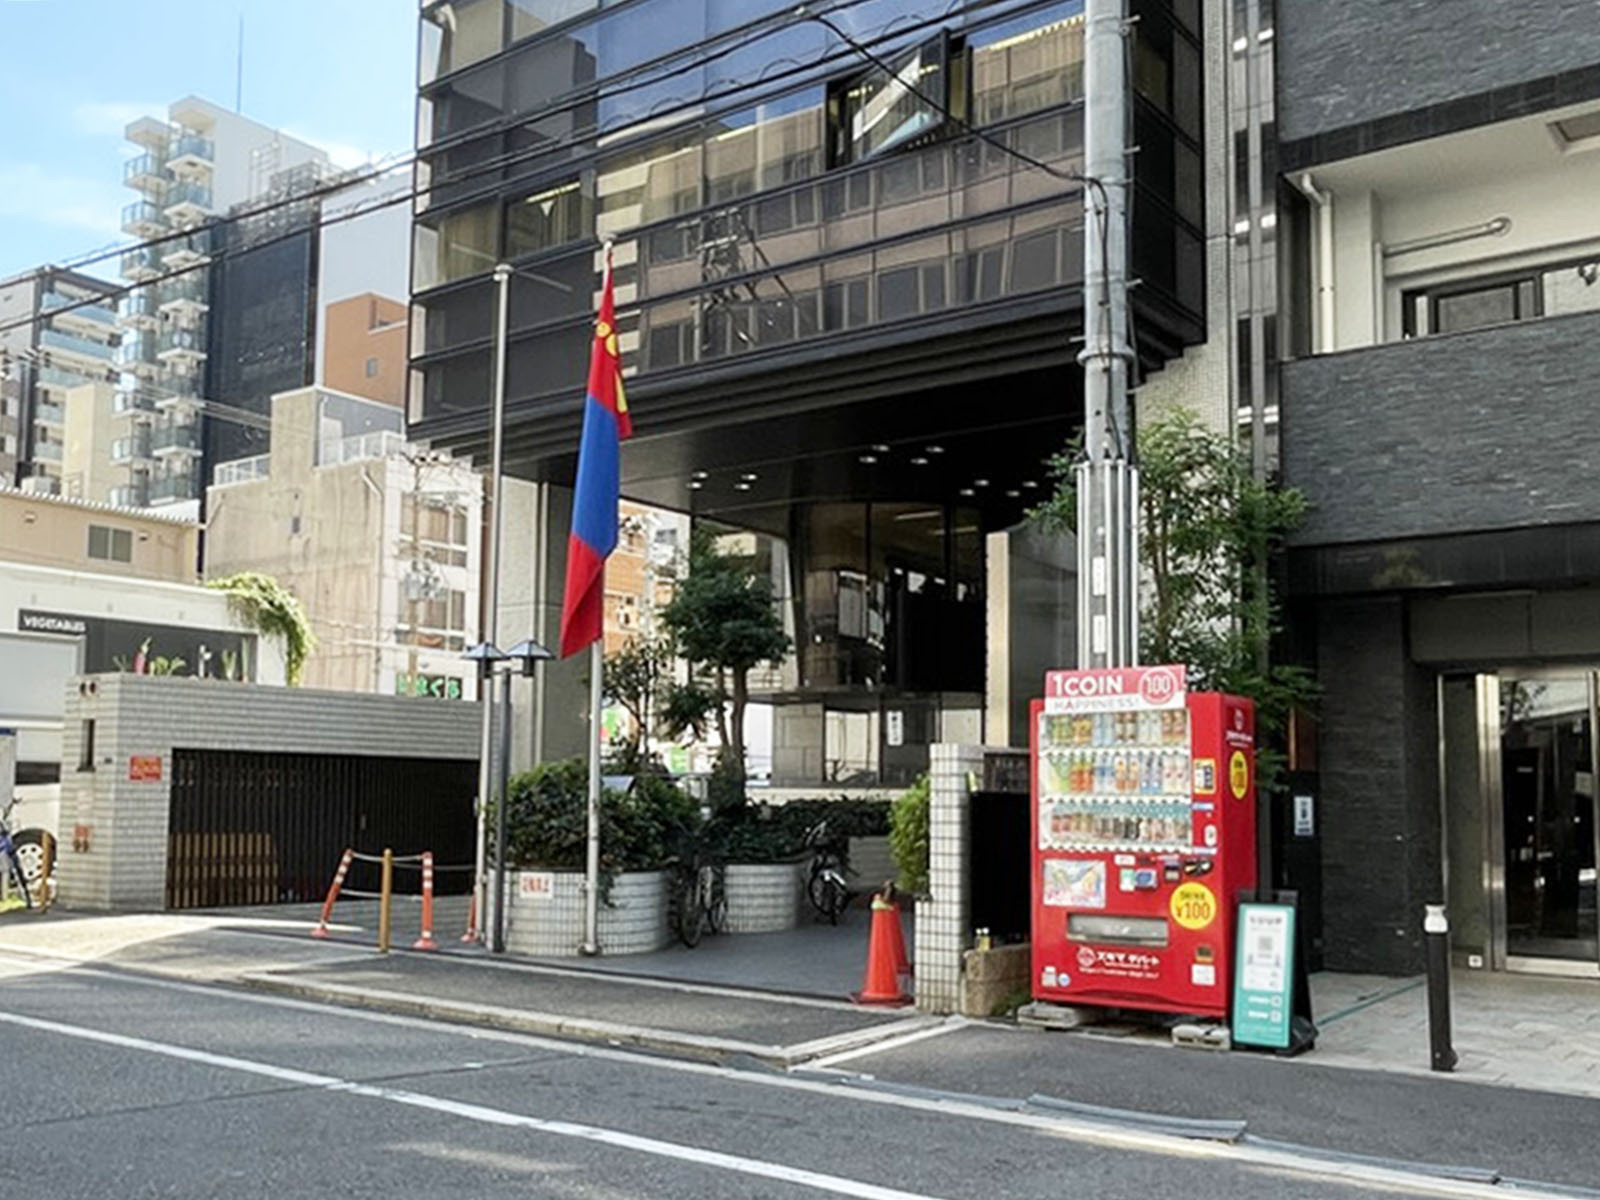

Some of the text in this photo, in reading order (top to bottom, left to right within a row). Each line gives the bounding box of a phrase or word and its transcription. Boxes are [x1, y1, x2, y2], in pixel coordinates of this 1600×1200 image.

[23, 615, 86, 632] VEGETABLES
[1053, 675, 1122, 696] 1COIN
[1145, 675, 1170, 694] 100
